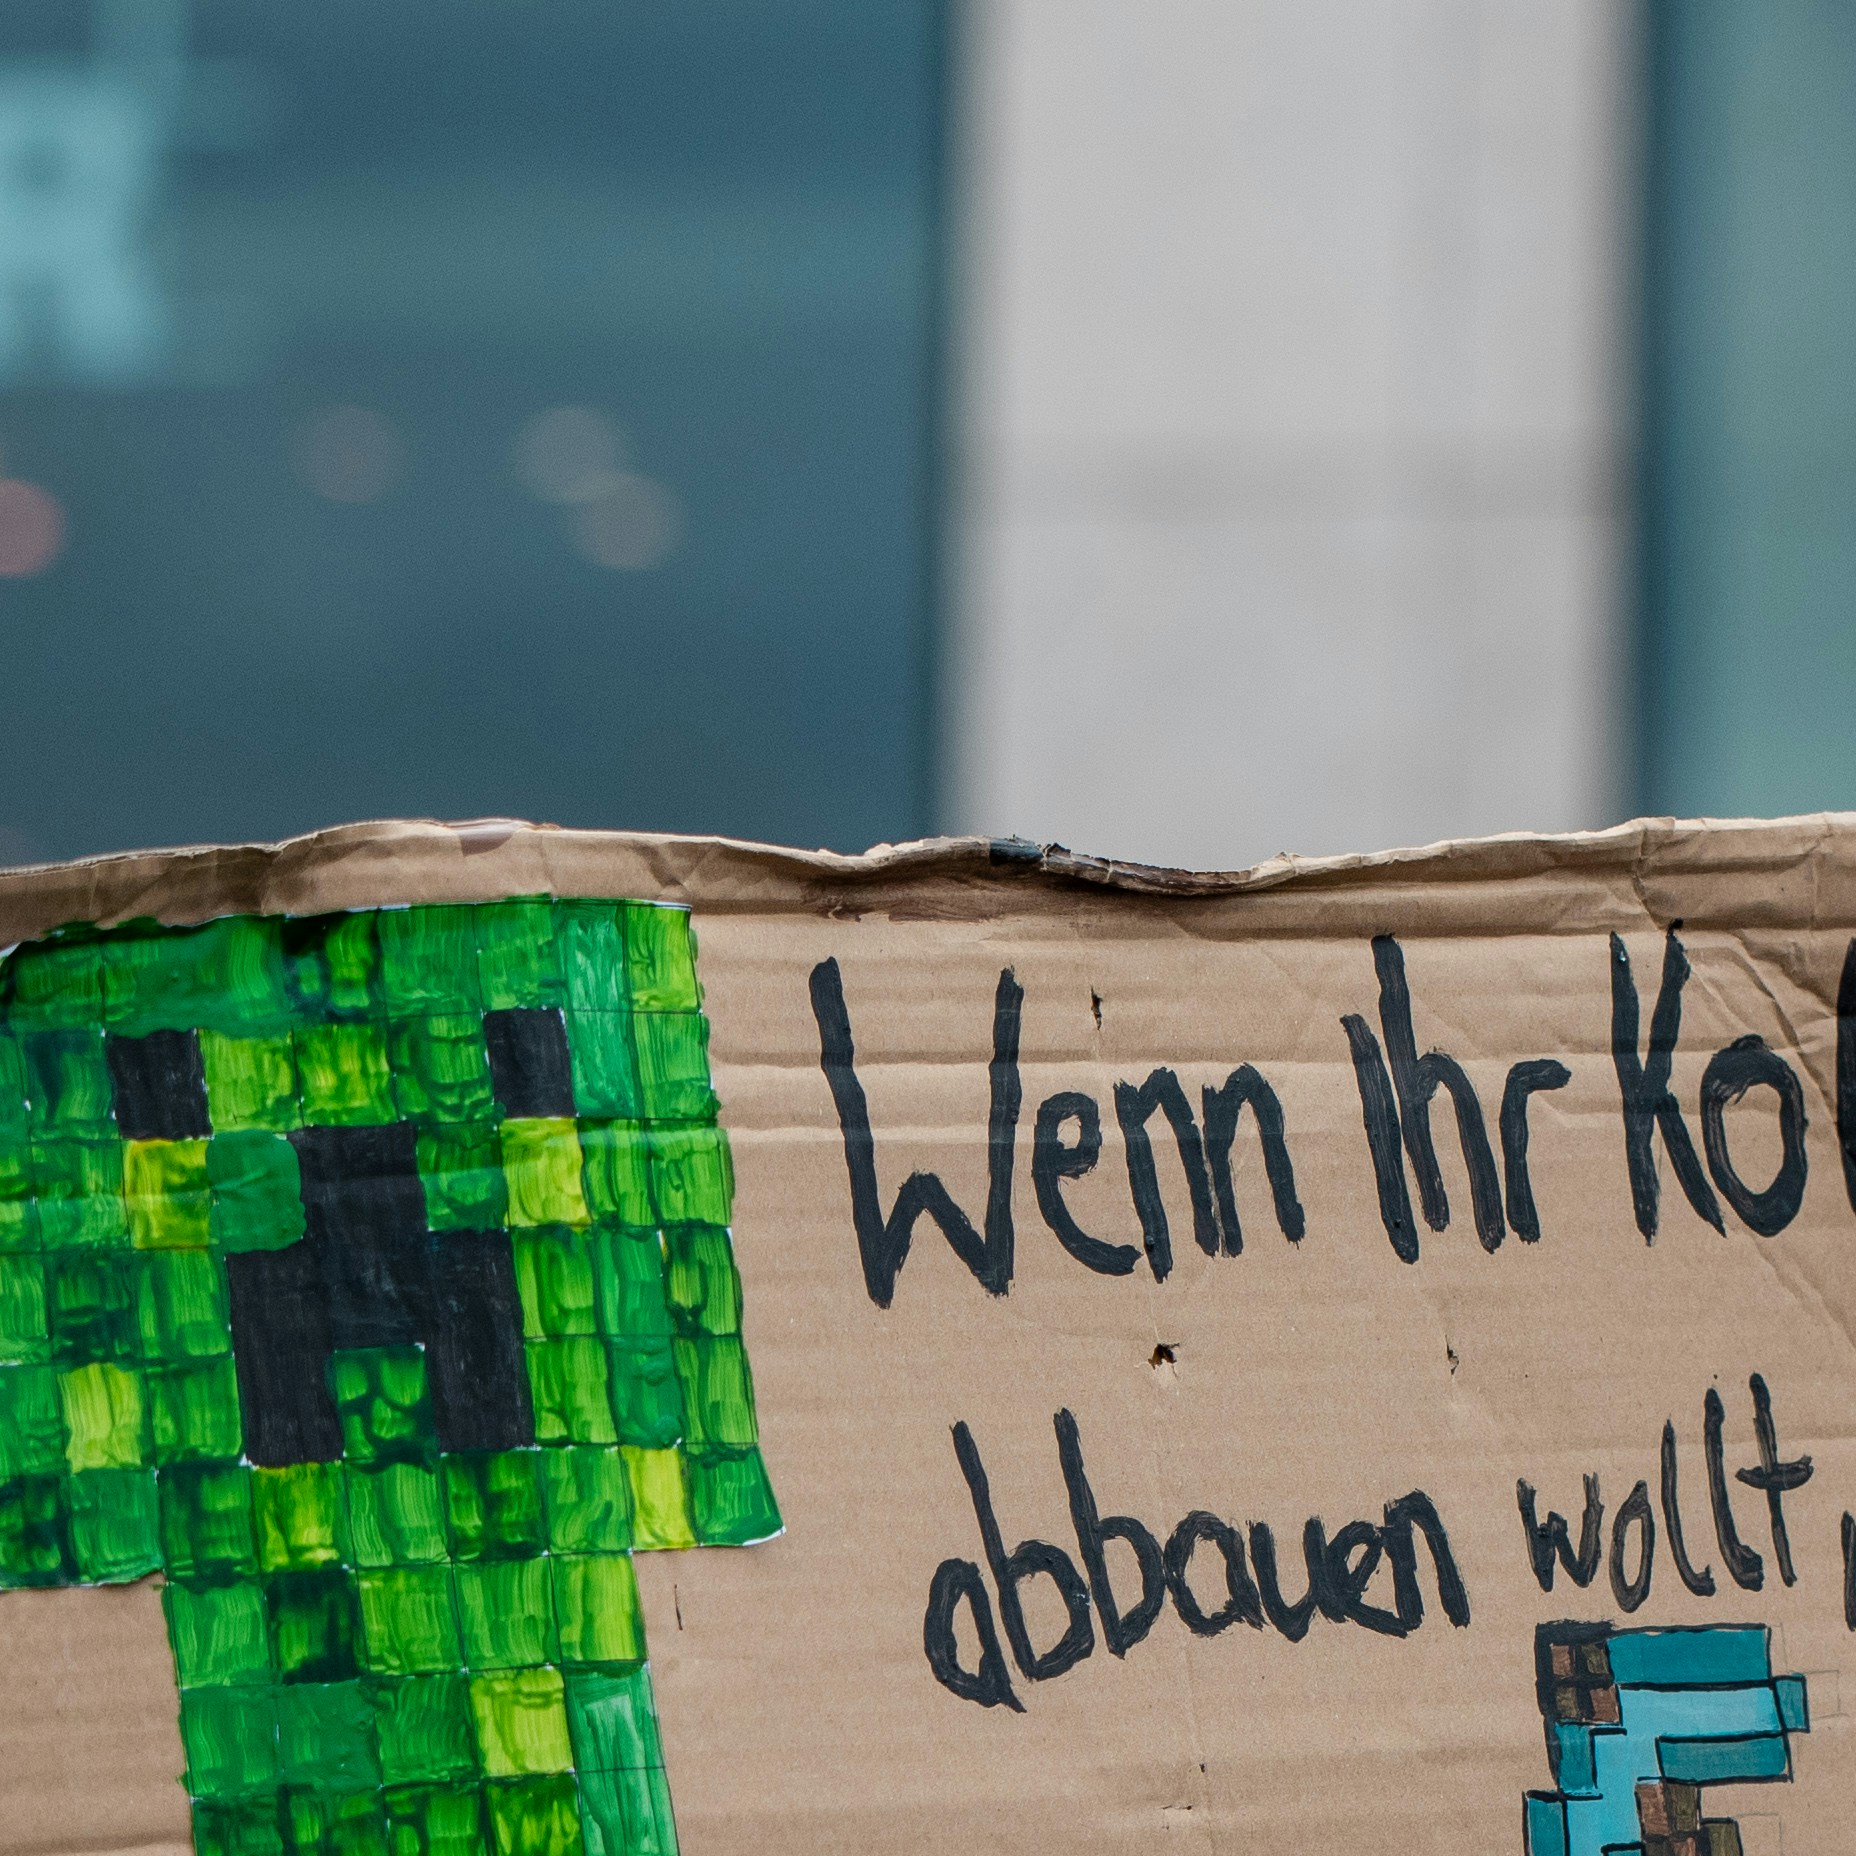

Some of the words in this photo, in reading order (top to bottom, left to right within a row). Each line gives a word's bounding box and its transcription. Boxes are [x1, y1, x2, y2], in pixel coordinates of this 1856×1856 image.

[807, 955, 1307, 1308] Wenn
[1342, 932, 1572, 1265] Ihr
[922, 1407, 1472, 1713] abbauen
